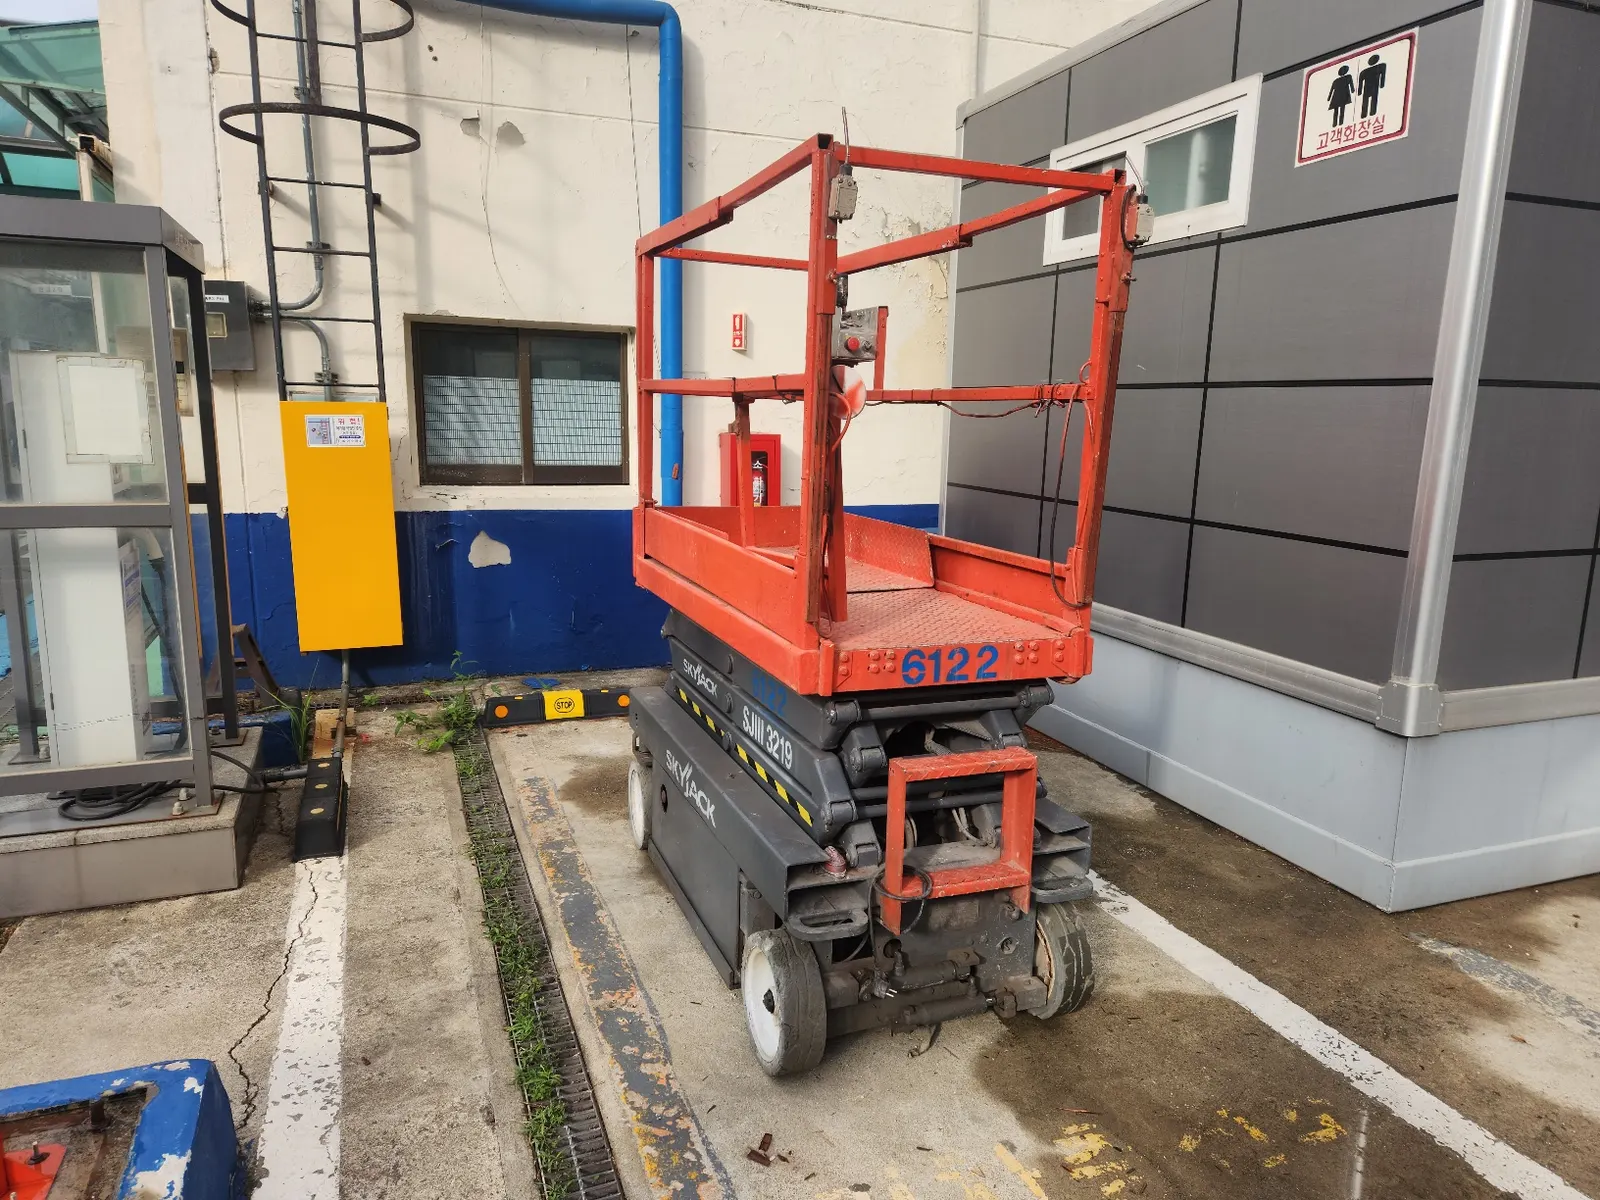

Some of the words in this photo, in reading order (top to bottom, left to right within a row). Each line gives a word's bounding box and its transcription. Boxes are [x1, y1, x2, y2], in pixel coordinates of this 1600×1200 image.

[1316, 114, 1386, 150] 고객화장실
[683, 658, 718, 697] SKYJACK
[901, 645, 999, 685] 6122
[556, 701, 573, 710] STOP
[766, 724, 793, 770] 3219
[666, 749, 717, 828] SKYJACK
